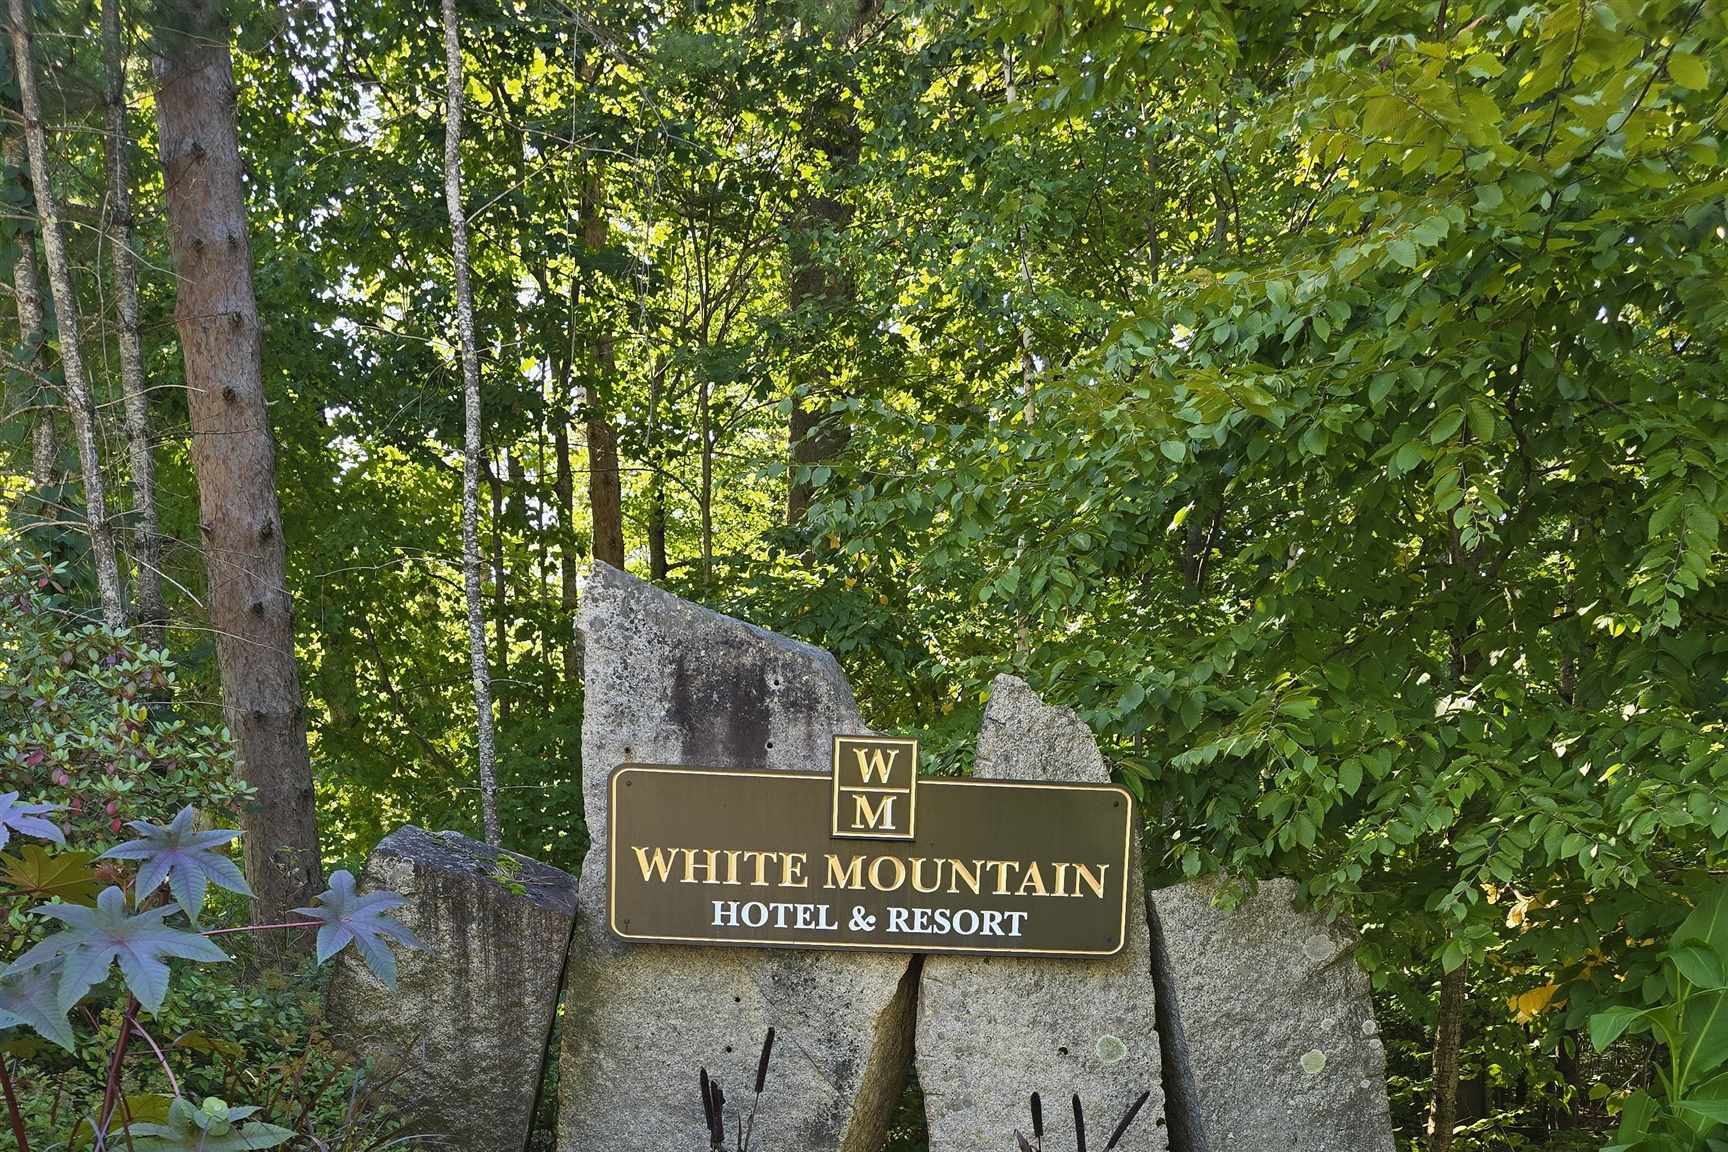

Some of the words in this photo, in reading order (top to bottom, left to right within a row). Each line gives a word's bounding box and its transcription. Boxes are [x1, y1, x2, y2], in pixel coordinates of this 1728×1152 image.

[852, 747, 900, 784] W
[851, 793, 897, 831] M
[631, 846, 808, 889] WHITE
[824, 853, 1110, 900] MOUNTAIN
[711, 900, 838, 932] HOTEL
[849, 905, 877, 933] &
[886, 906, 1028, 937] RESORT
